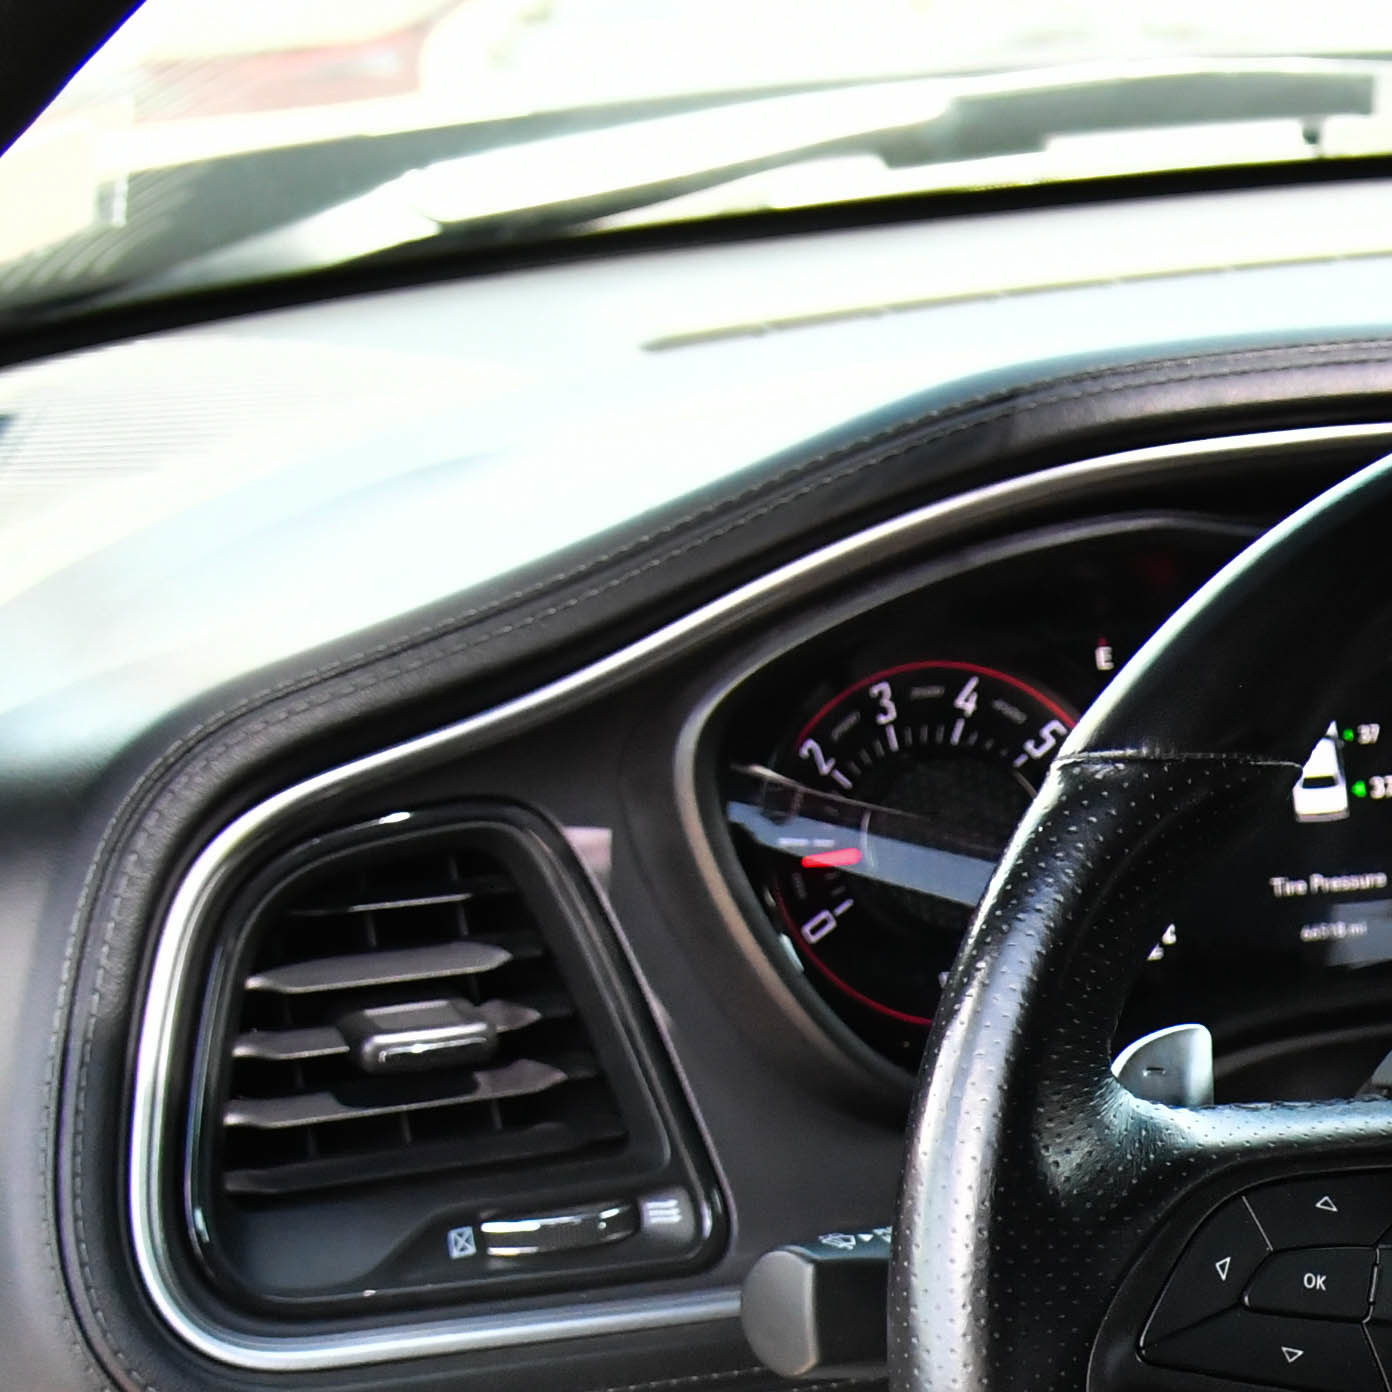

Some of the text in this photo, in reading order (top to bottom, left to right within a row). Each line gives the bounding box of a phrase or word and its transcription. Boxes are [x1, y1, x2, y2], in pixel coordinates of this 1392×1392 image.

[1095, 646, 1114, 671] E
[868, 681, 898, 725] 3
[954, 676, 979, 717] 4
[800, 738, 836, 776] 2
[1024, 719, 1068, 760] 5
[1270, 873, 1388, 897] Tire Pressure
[801, 909, 836, 944] 0
[1303, 1272, 1326, 1291] OK
